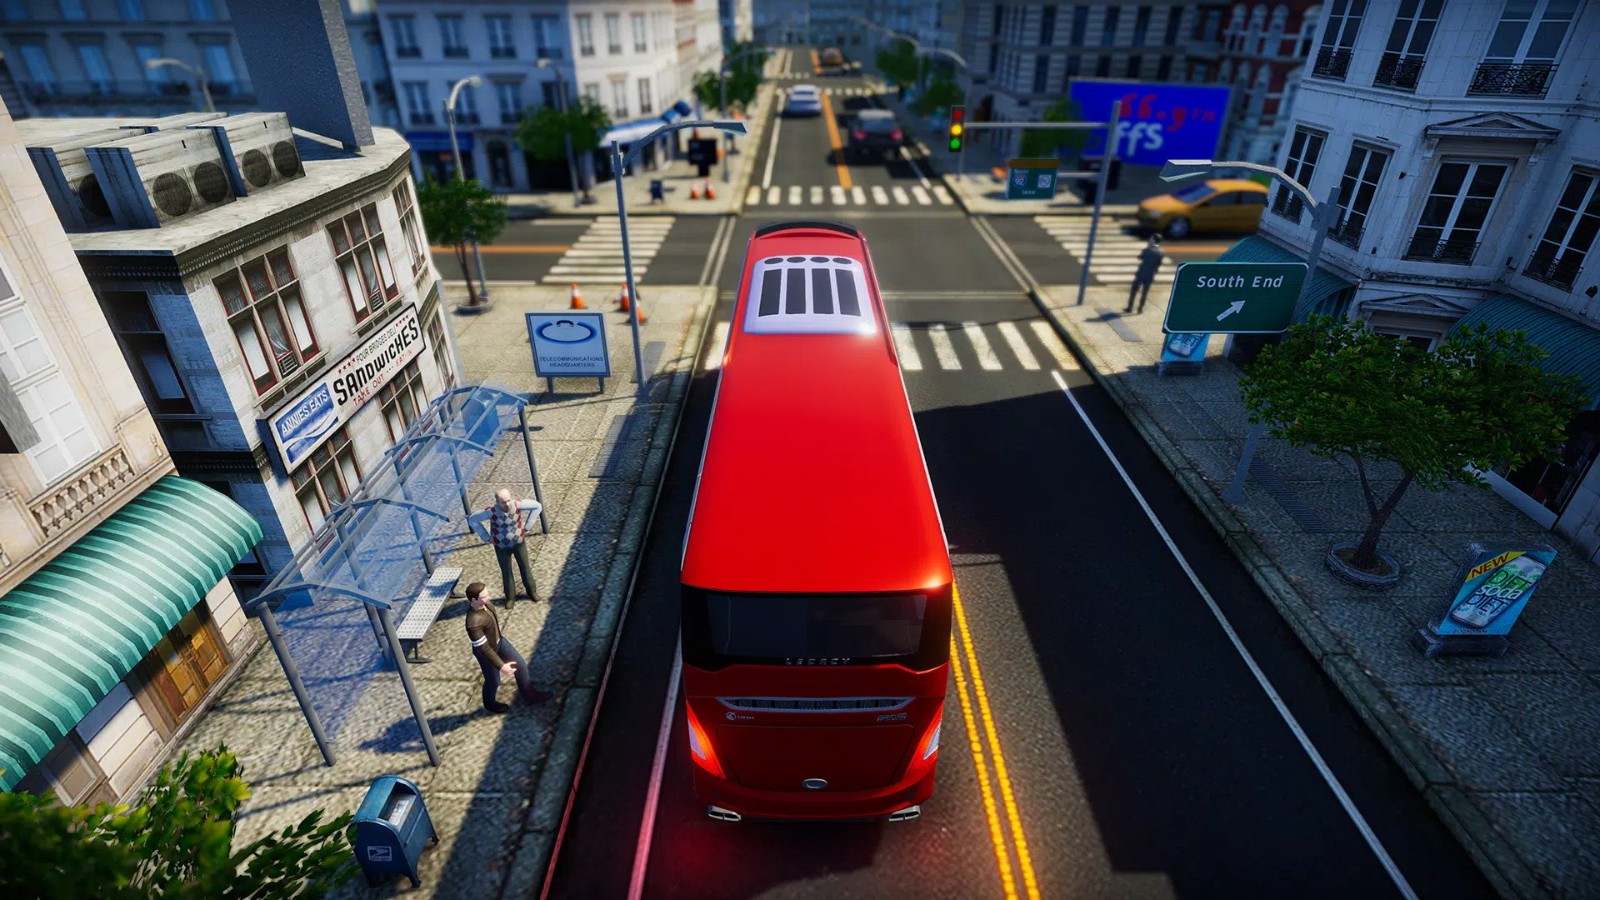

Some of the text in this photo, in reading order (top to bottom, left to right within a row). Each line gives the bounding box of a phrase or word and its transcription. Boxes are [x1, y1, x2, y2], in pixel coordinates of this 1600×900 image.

[1014, 178, 1025, 186] 92
[1196, 275, 1284, 288] South End
[356, 347, 369, 363] FOUR
[369, 333, 388, 353] BRIDGES
[333, 317, 419, 406] SANDWICHES
[352, 387, 371, 406] TAKE
[372, 373, 385, 388] OUT
[281, 390, 328, 437] ANNIES EATS
[1471, 552, 1509, 578] NEW
[1489, 569, 1532, 591] DIET
[1466, 593, 1509, 614] DIET
[1476, 585, 1523, 600] soda
